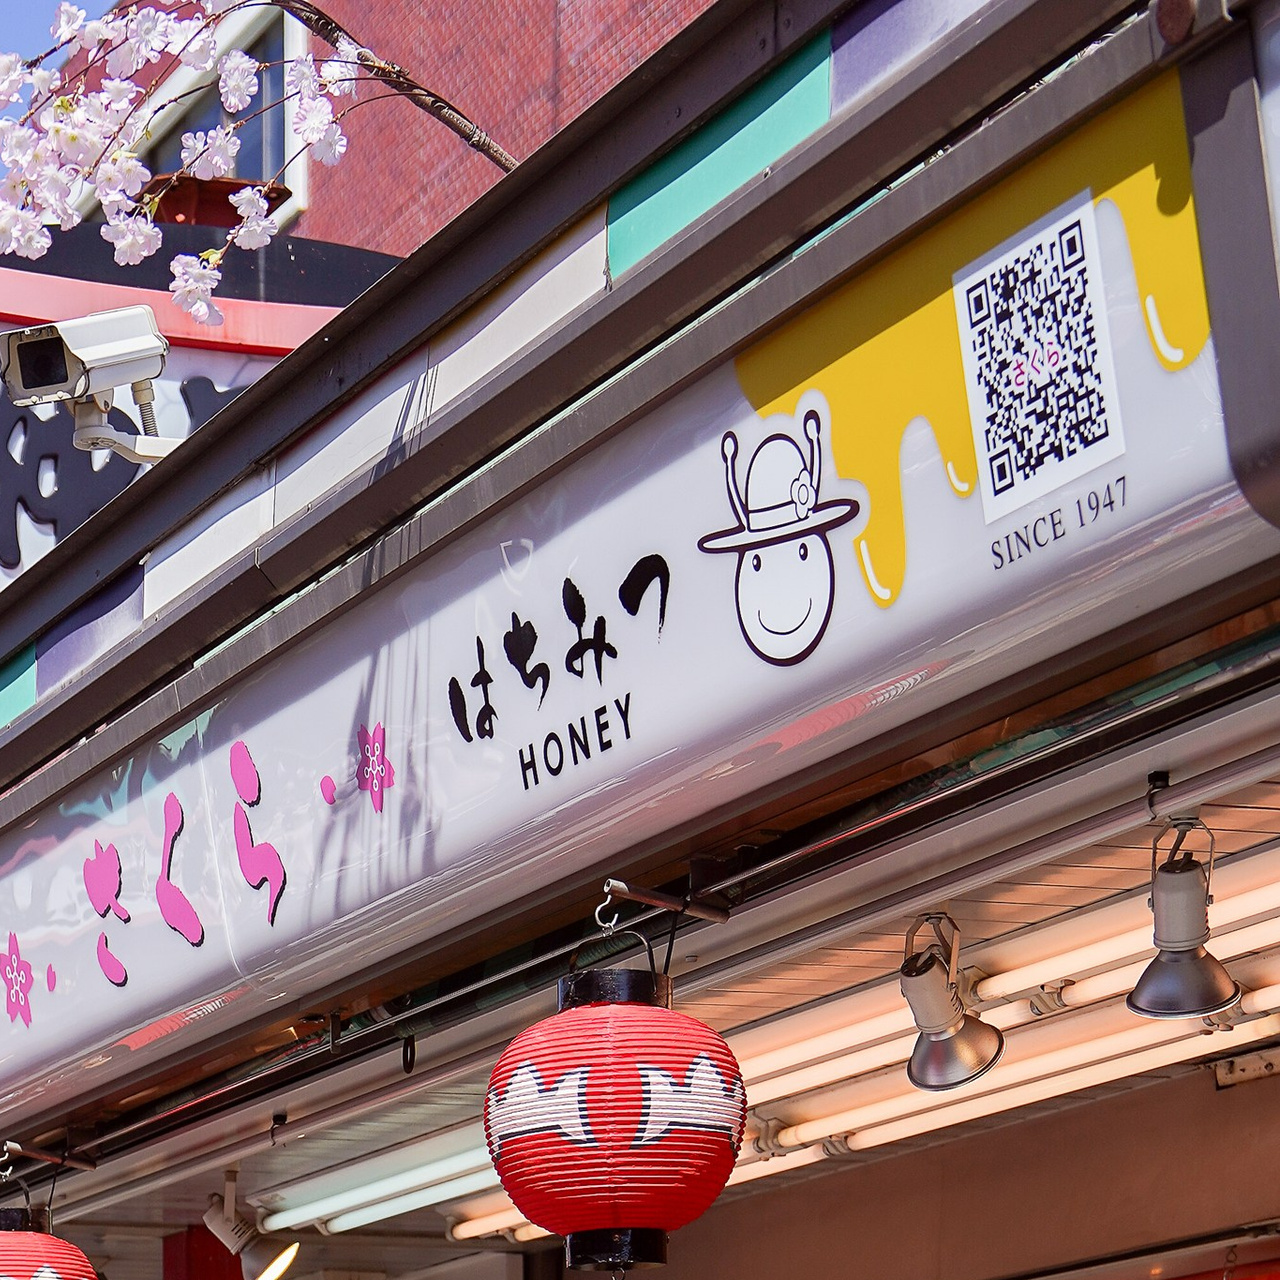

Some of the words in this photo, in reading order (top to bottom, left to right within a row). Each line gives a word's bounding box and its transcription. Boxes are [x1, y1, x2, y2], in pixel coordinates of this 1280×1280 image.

[1012, 341, 1060, 387] さくら
[990, 508, 1066, 571] SINCE
[1075, 475, 1126, 529] 1947
[448, 553, 671, 743] はちみつ
[518, 691, 632, 791] HONEY
[82, 739, 287, 988] さくら
